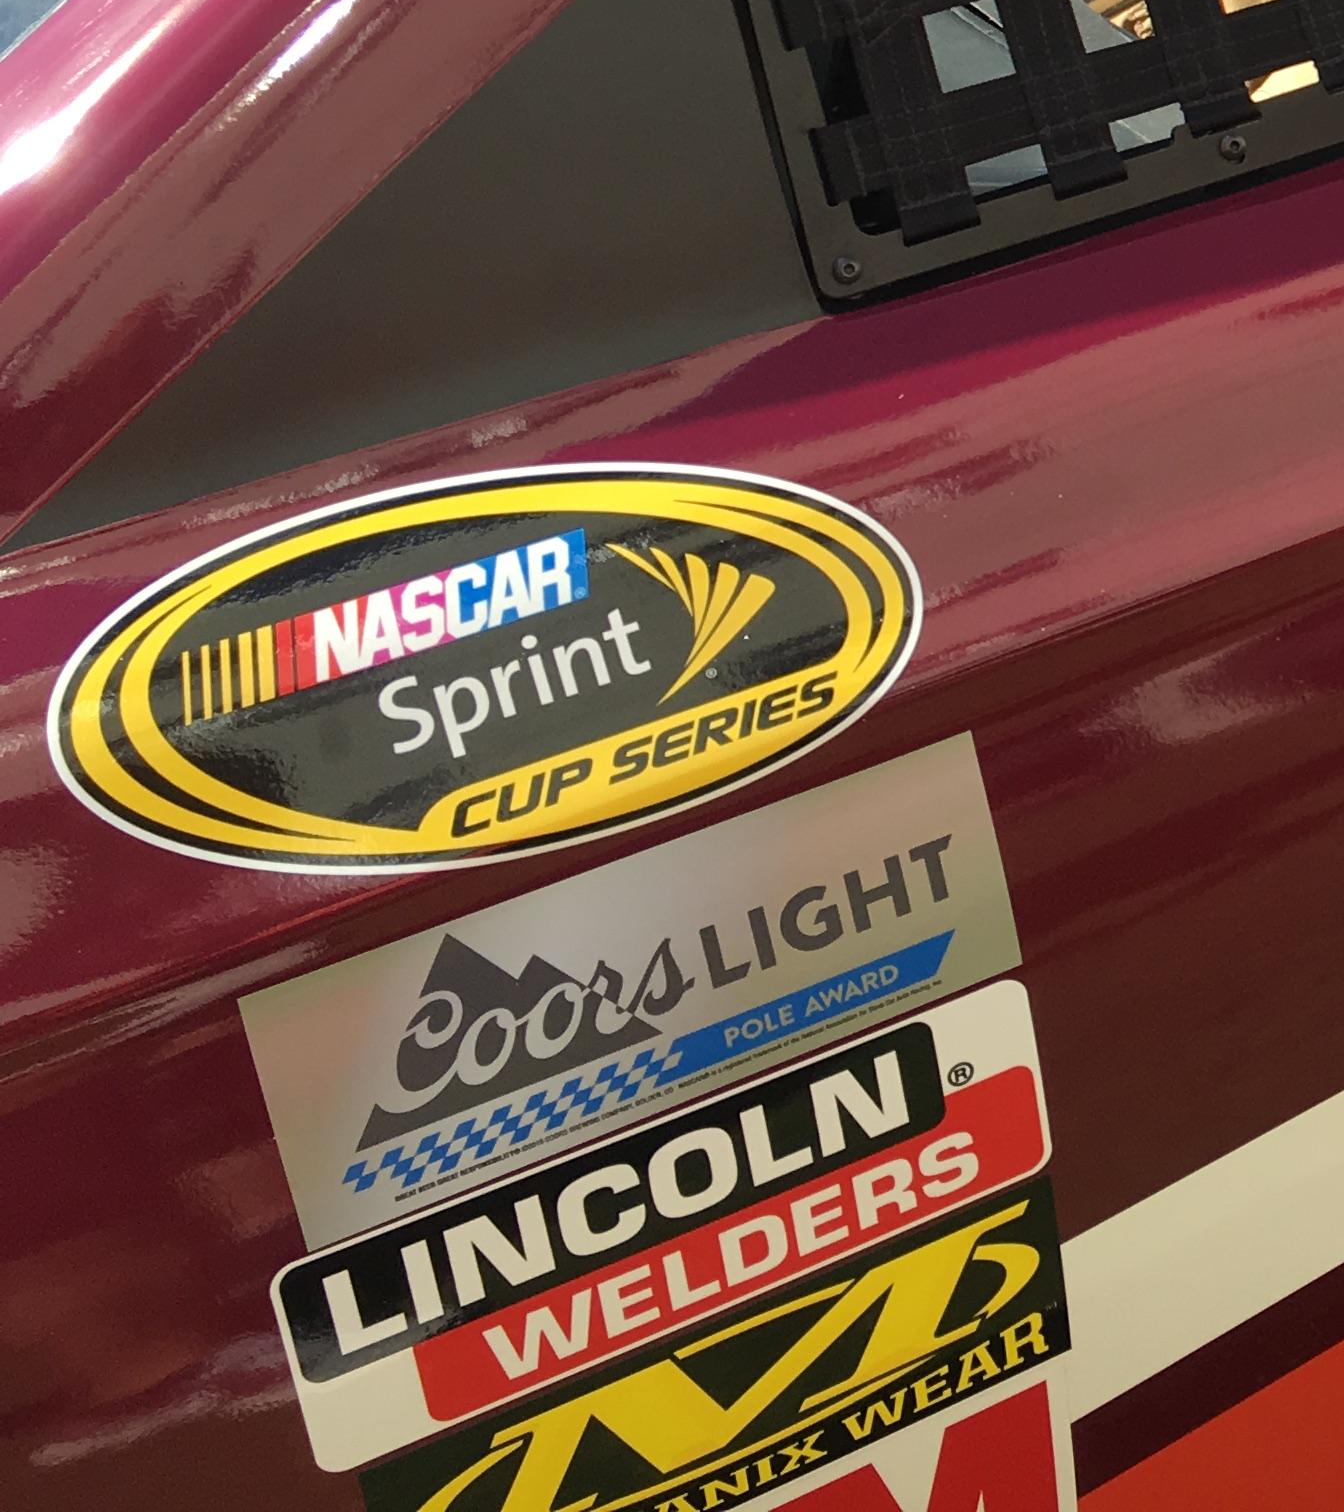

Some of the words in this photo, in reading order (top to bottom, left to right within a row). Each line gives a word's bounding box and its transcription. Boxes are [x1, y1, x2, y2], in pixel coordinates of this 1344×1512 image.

[312, 535, 576, 681] NASCAR
[378, 607, 652, 759] Sprint
[451, 768, 593, 840] CUP
[608, 669, 840, 780] SERIES
[371, 936, 696, 1114] Coors
[700, 833, 954, 989] LIGHT
[724, 1004, 796, 1048] POLE
[804, 964, 899, 1018] AWARD
[321, 1048, 914, 1356] LINCOLN
[481, 1131, 980, 1381] WELDERS
[844, 1310, 1051, 1441] WEAR
